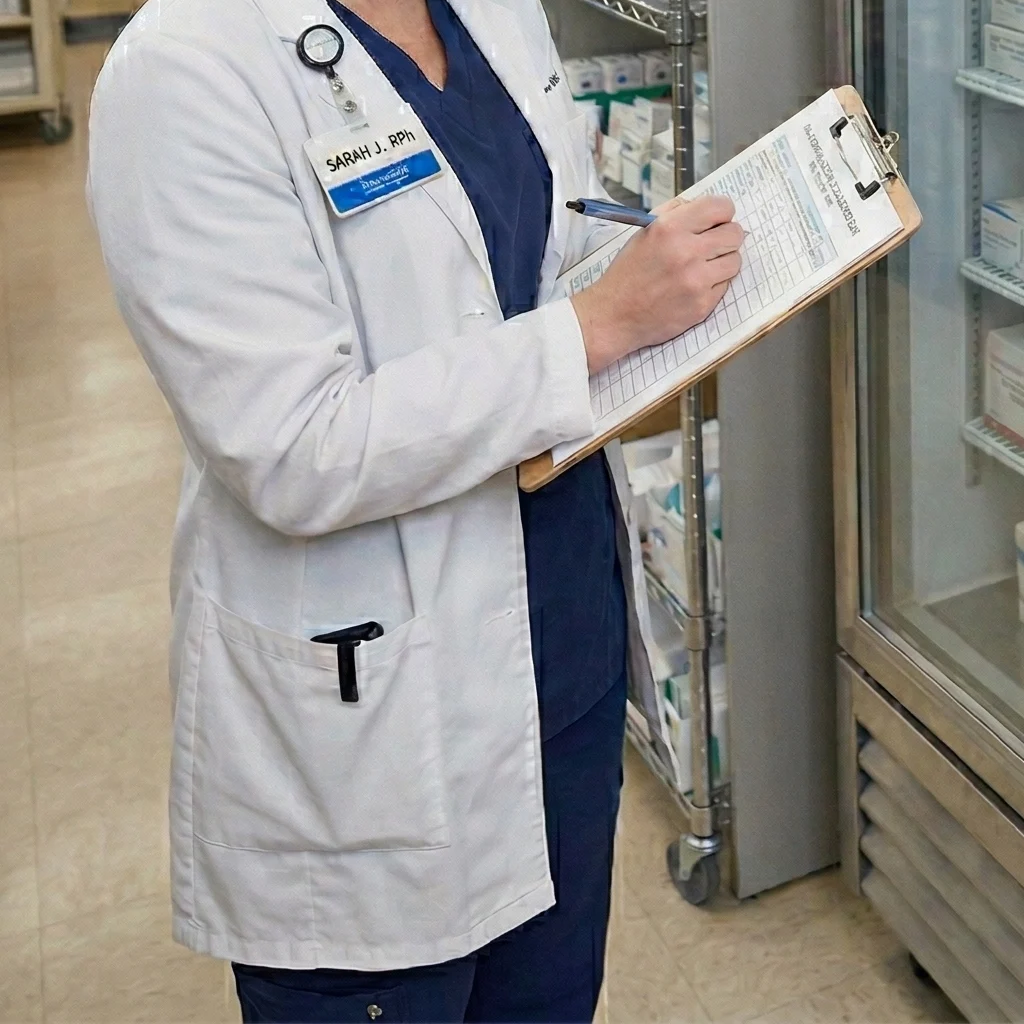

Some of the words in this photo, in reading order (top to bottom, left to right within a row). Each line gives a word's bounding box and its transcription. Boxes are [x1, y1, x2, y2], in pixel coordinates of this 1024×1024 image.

[326, 144, 372, 173] SARAH
[375, 141, 387, 155] J.
[388, 129, 416, 148] RPh
